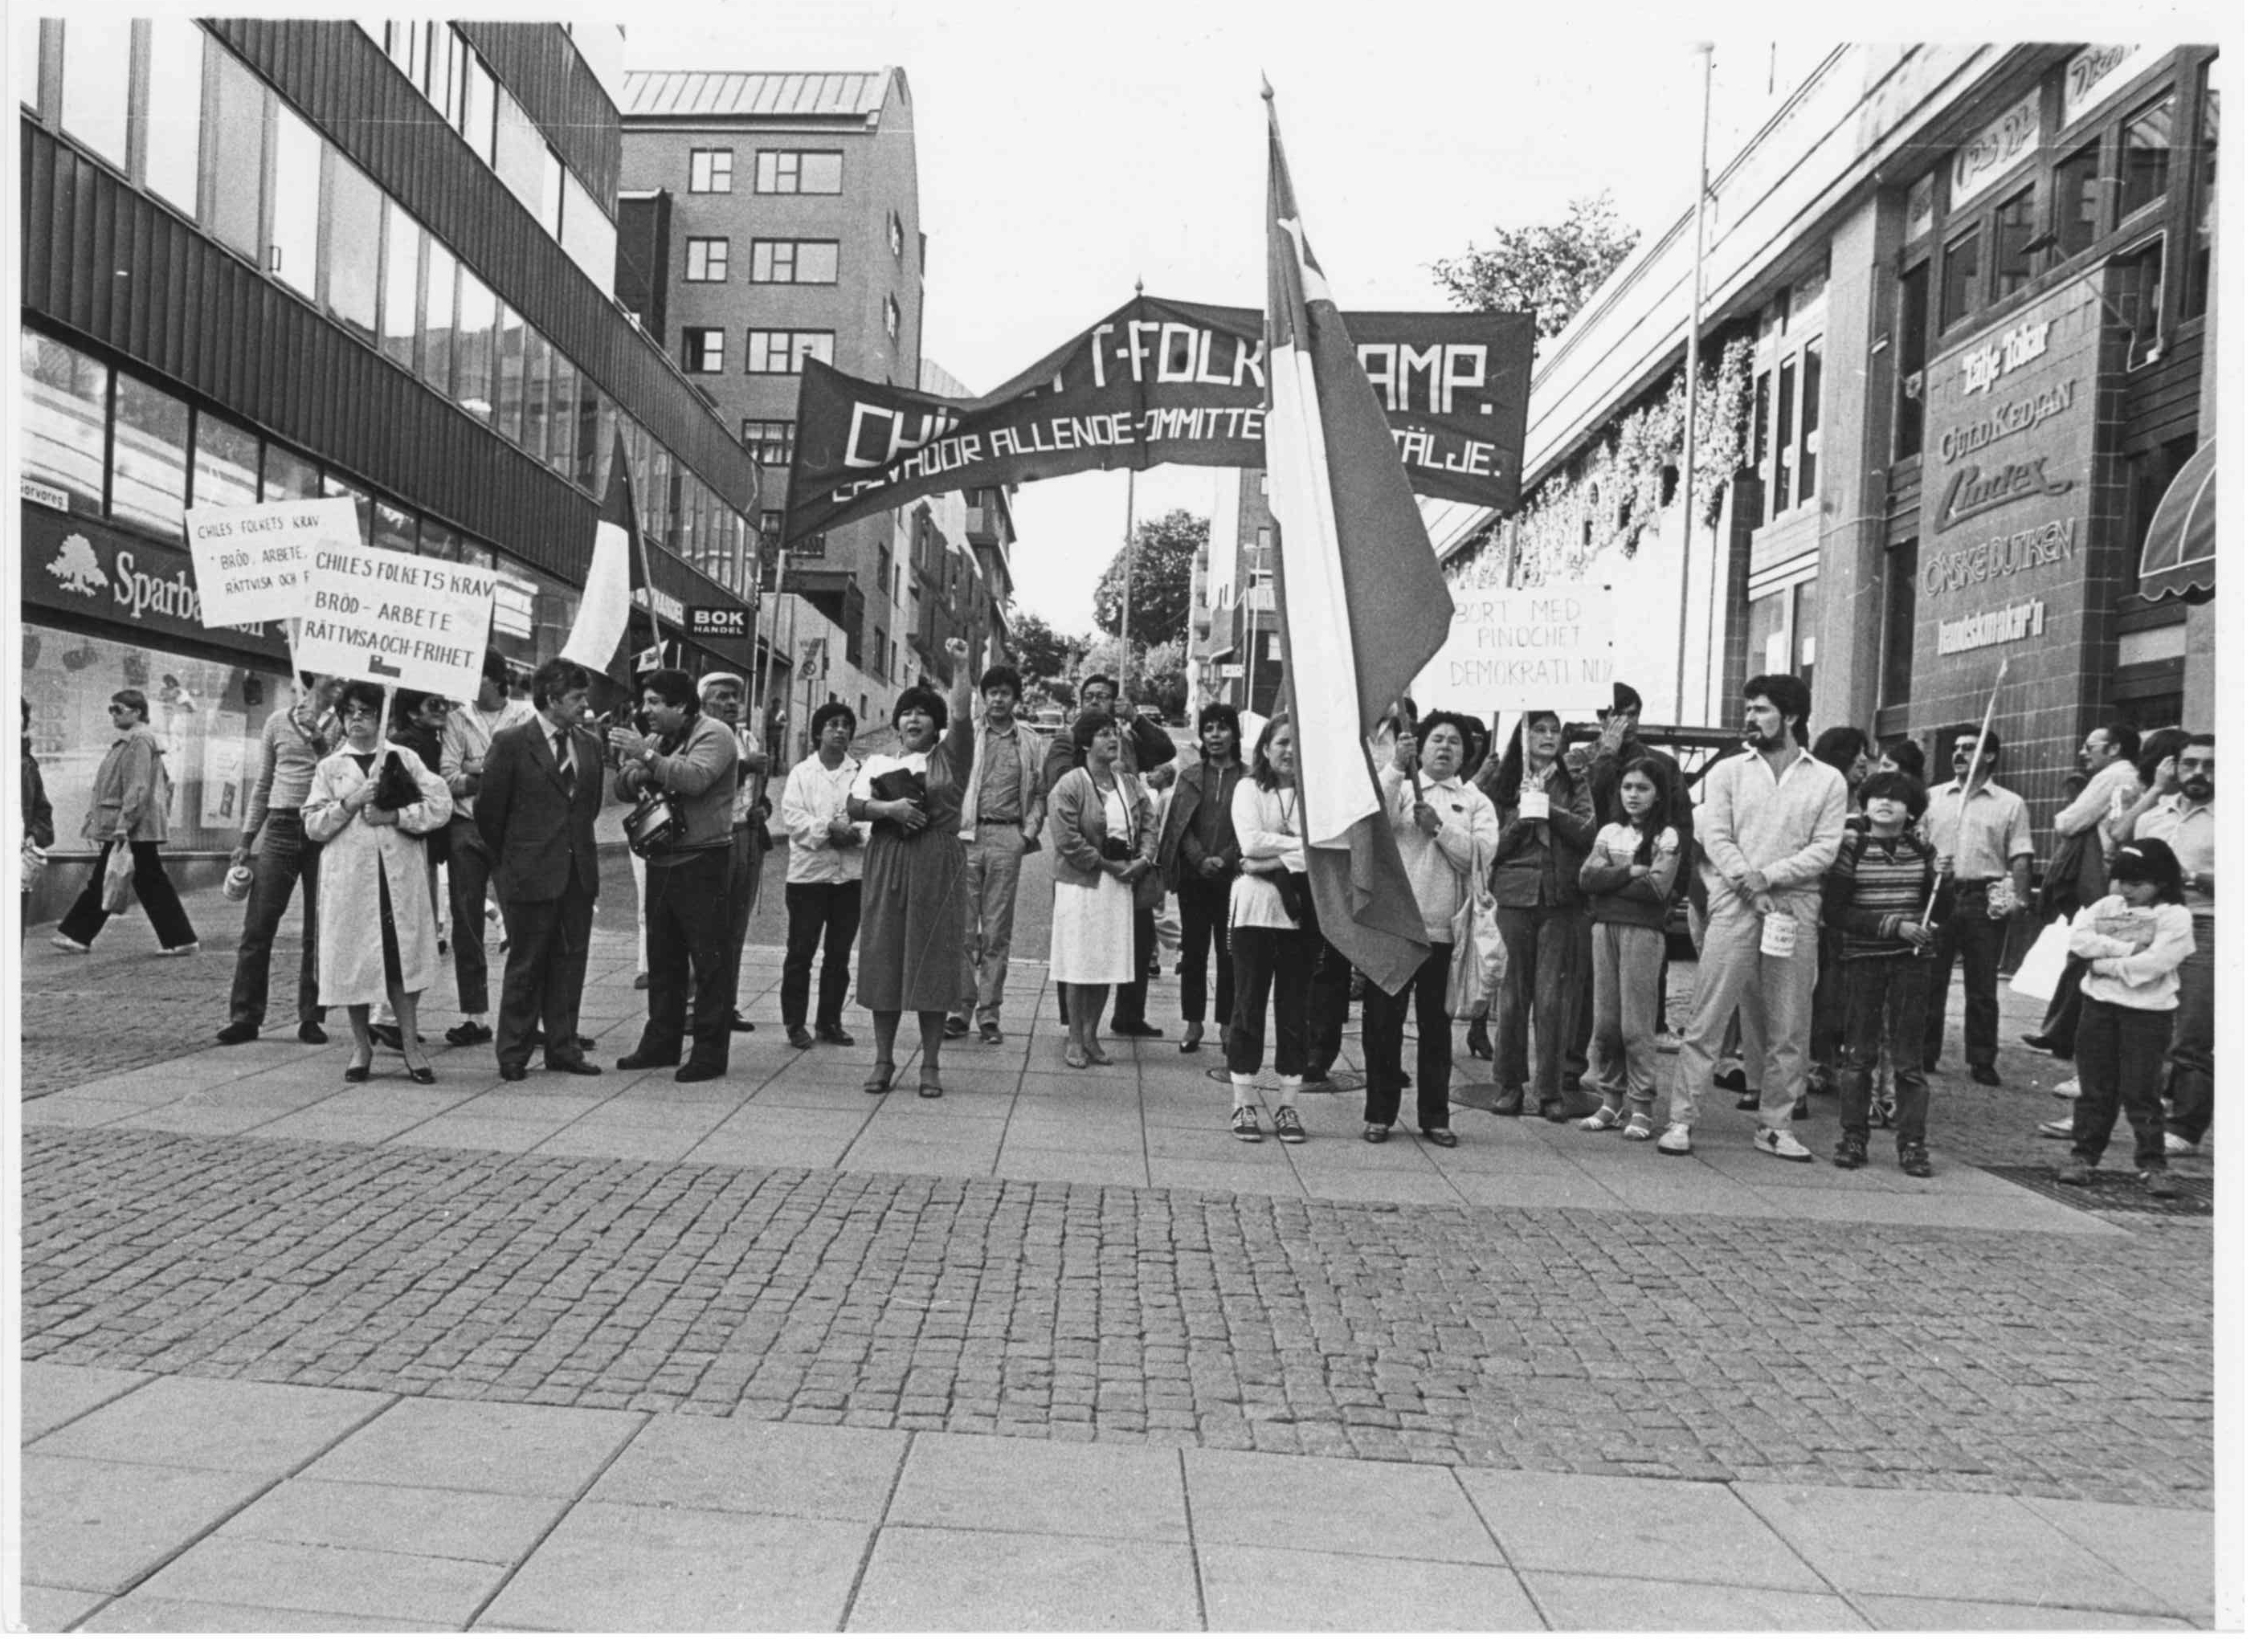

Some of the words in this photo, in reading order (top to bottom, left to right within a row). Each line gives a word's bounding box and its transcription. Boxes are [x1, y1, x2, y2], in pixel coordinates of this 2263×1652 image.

[1051, 320, 1265, 394] T-FOLK
[1357, 343, 1493, 414] AMP.
[844, 401, 960, 468] CHI
[1933, 456, 2075, 536] Lindex
[197, 521, 234, 540] CHILES
[240, 516, 284, 535] FOLKETS
[292, 514, 321, 529] KRAV
[224, 576, 274, 595] RÄTTVISA
[278, 572, 297, 587] OCH
[316, 551, 372, 578] CHILES
[376, 561, 446, 590] FOLKETS
[450, 574, 496, 598] KRAV
[315, 590, 360, 614] BRÖD
[377, 602, 453, 632] ARBETE
[693, 610, 745, 626] BOK
[1455, 599, 1511, 625] BORT
[1530, 598, 1581, 623] MED
[692, 626, 744, 635] HANDEL
[1477, 625, 1581, 649] PINOCHET
[1449, 657, 1570, 687] DEMOKRATI
